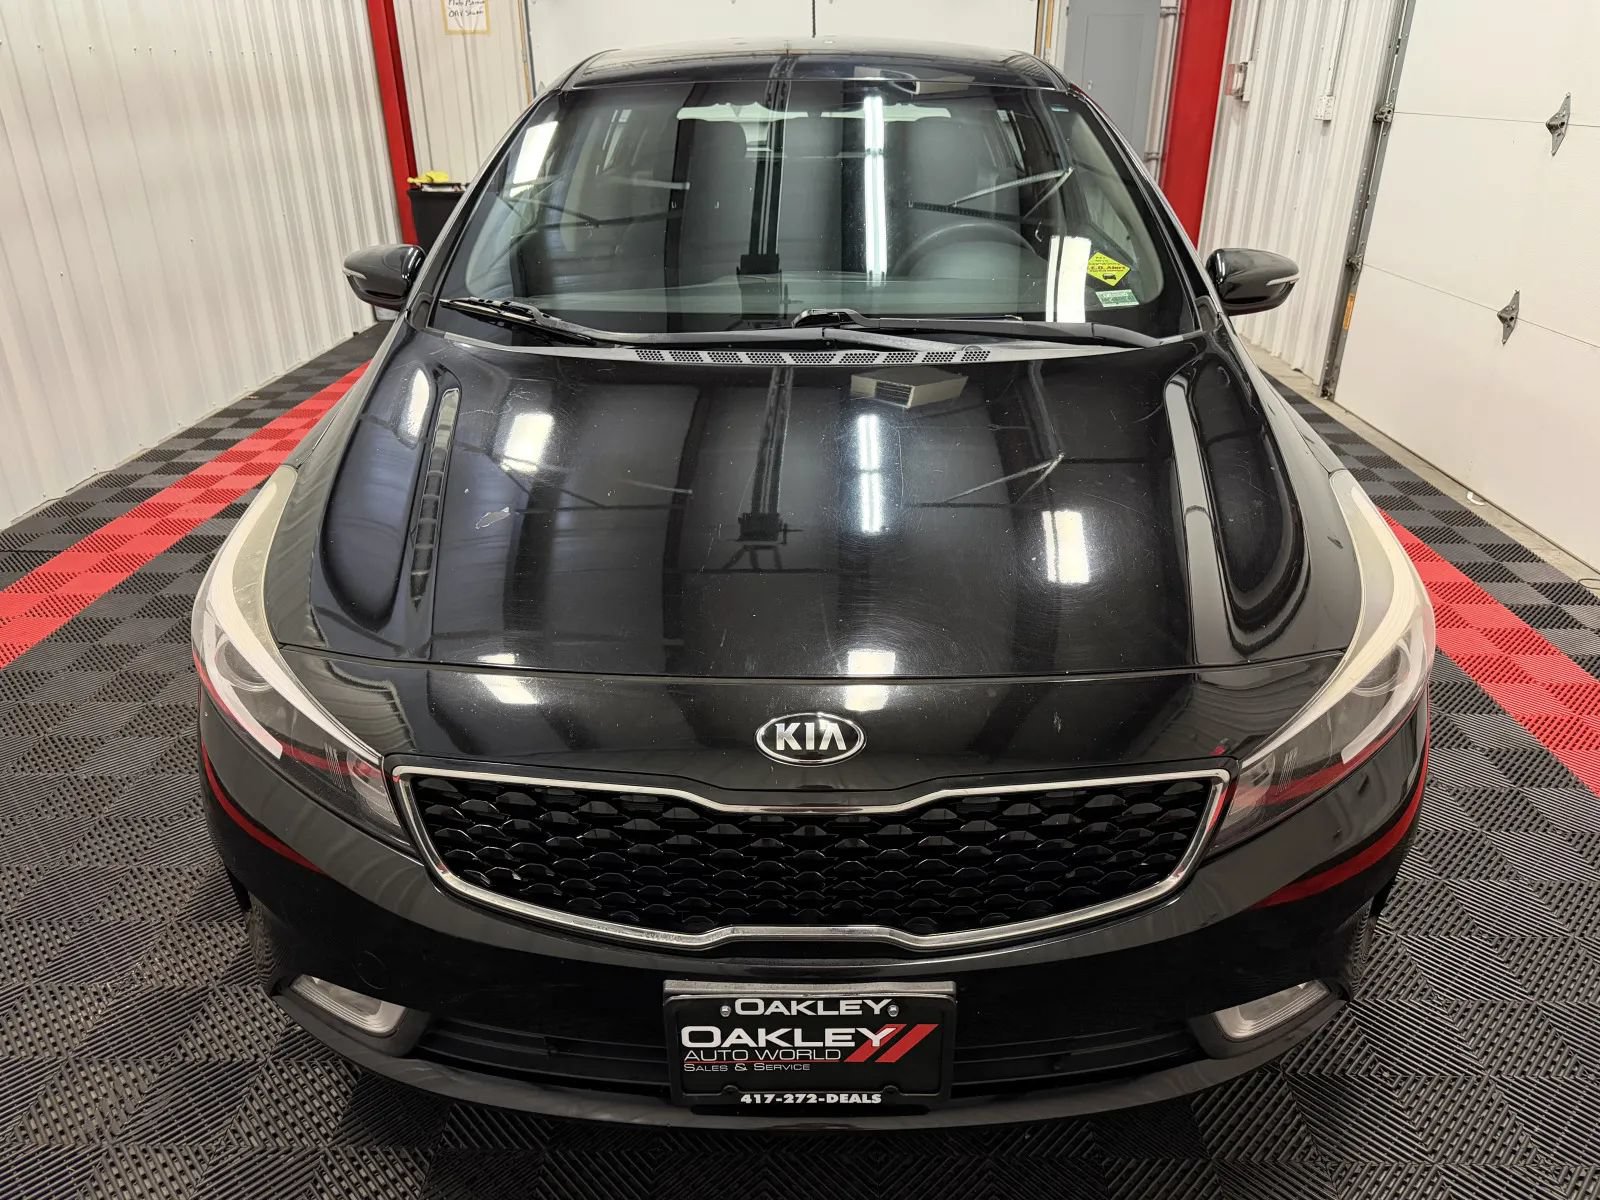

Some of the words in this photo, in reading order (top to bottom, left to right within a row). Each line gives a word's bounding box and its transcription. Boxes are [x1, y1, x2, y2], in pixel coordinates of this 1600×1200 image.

[775, 722, 847, 750] KIA
[734, 998, 892, 1016] OAKLEY
[681, 1026, 897, 1048] OAKLEY
[684, 1050, 748, 1062] AUTO
[754, 1049, 841, 1060] WORLD
[684, 1063, 728, 1072] SALES
[734, 1063, 748, 1072] &
[754, 1063, 810, 1071] SERVICE
[740, 1093, 882, 1104] 417-272-DEALS
